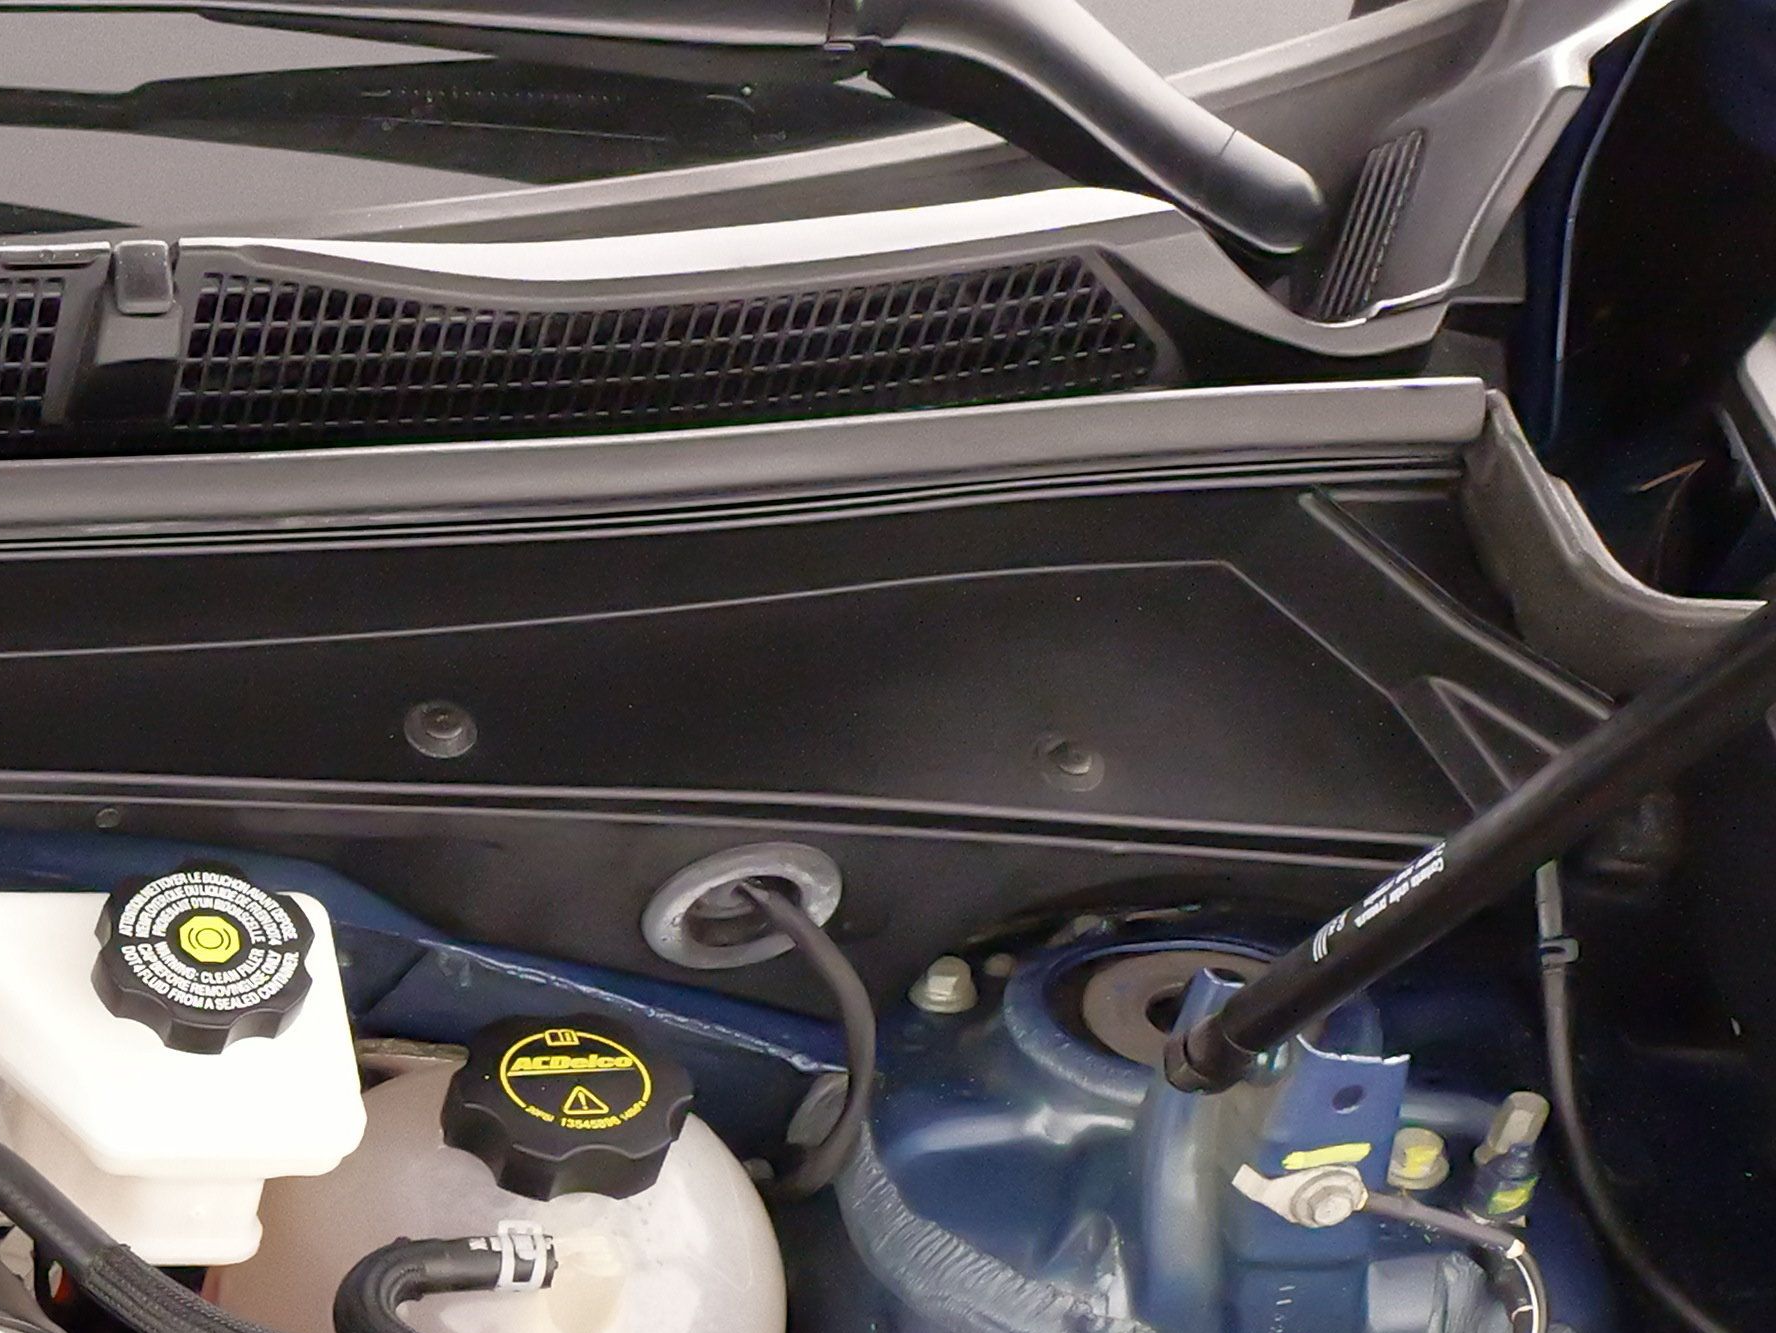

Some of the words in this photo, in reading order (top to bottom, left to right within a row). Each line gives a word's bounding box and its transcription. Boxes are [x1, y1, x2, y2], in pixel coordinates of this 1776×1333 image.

[183, 884, 200, 897] DU
[198, 884, 241, 902] LIQUIDE
[233, 891, 255, 908] DE
[186, 871, 202, 884] LE
[201, 871, 251, 894] BOUCHON
[245, 887, 280, 912] AVANT
[137, 943, 159, 964] CAP
[148, 960, 192, 994] BEFORE
[256, 949, 283, 975] ONLY
[200, 968, 241, 985] CLEAN
[235, 947, 266, 978] FILLER
[136, 968, 171, 995] FLUID
[166, 987, 205, 1008] FROM
[203, 997, 215, 1010] A
[214, 989, 261, 1011] SEALED
[510, 1054, 634, 1071] ACDelco
